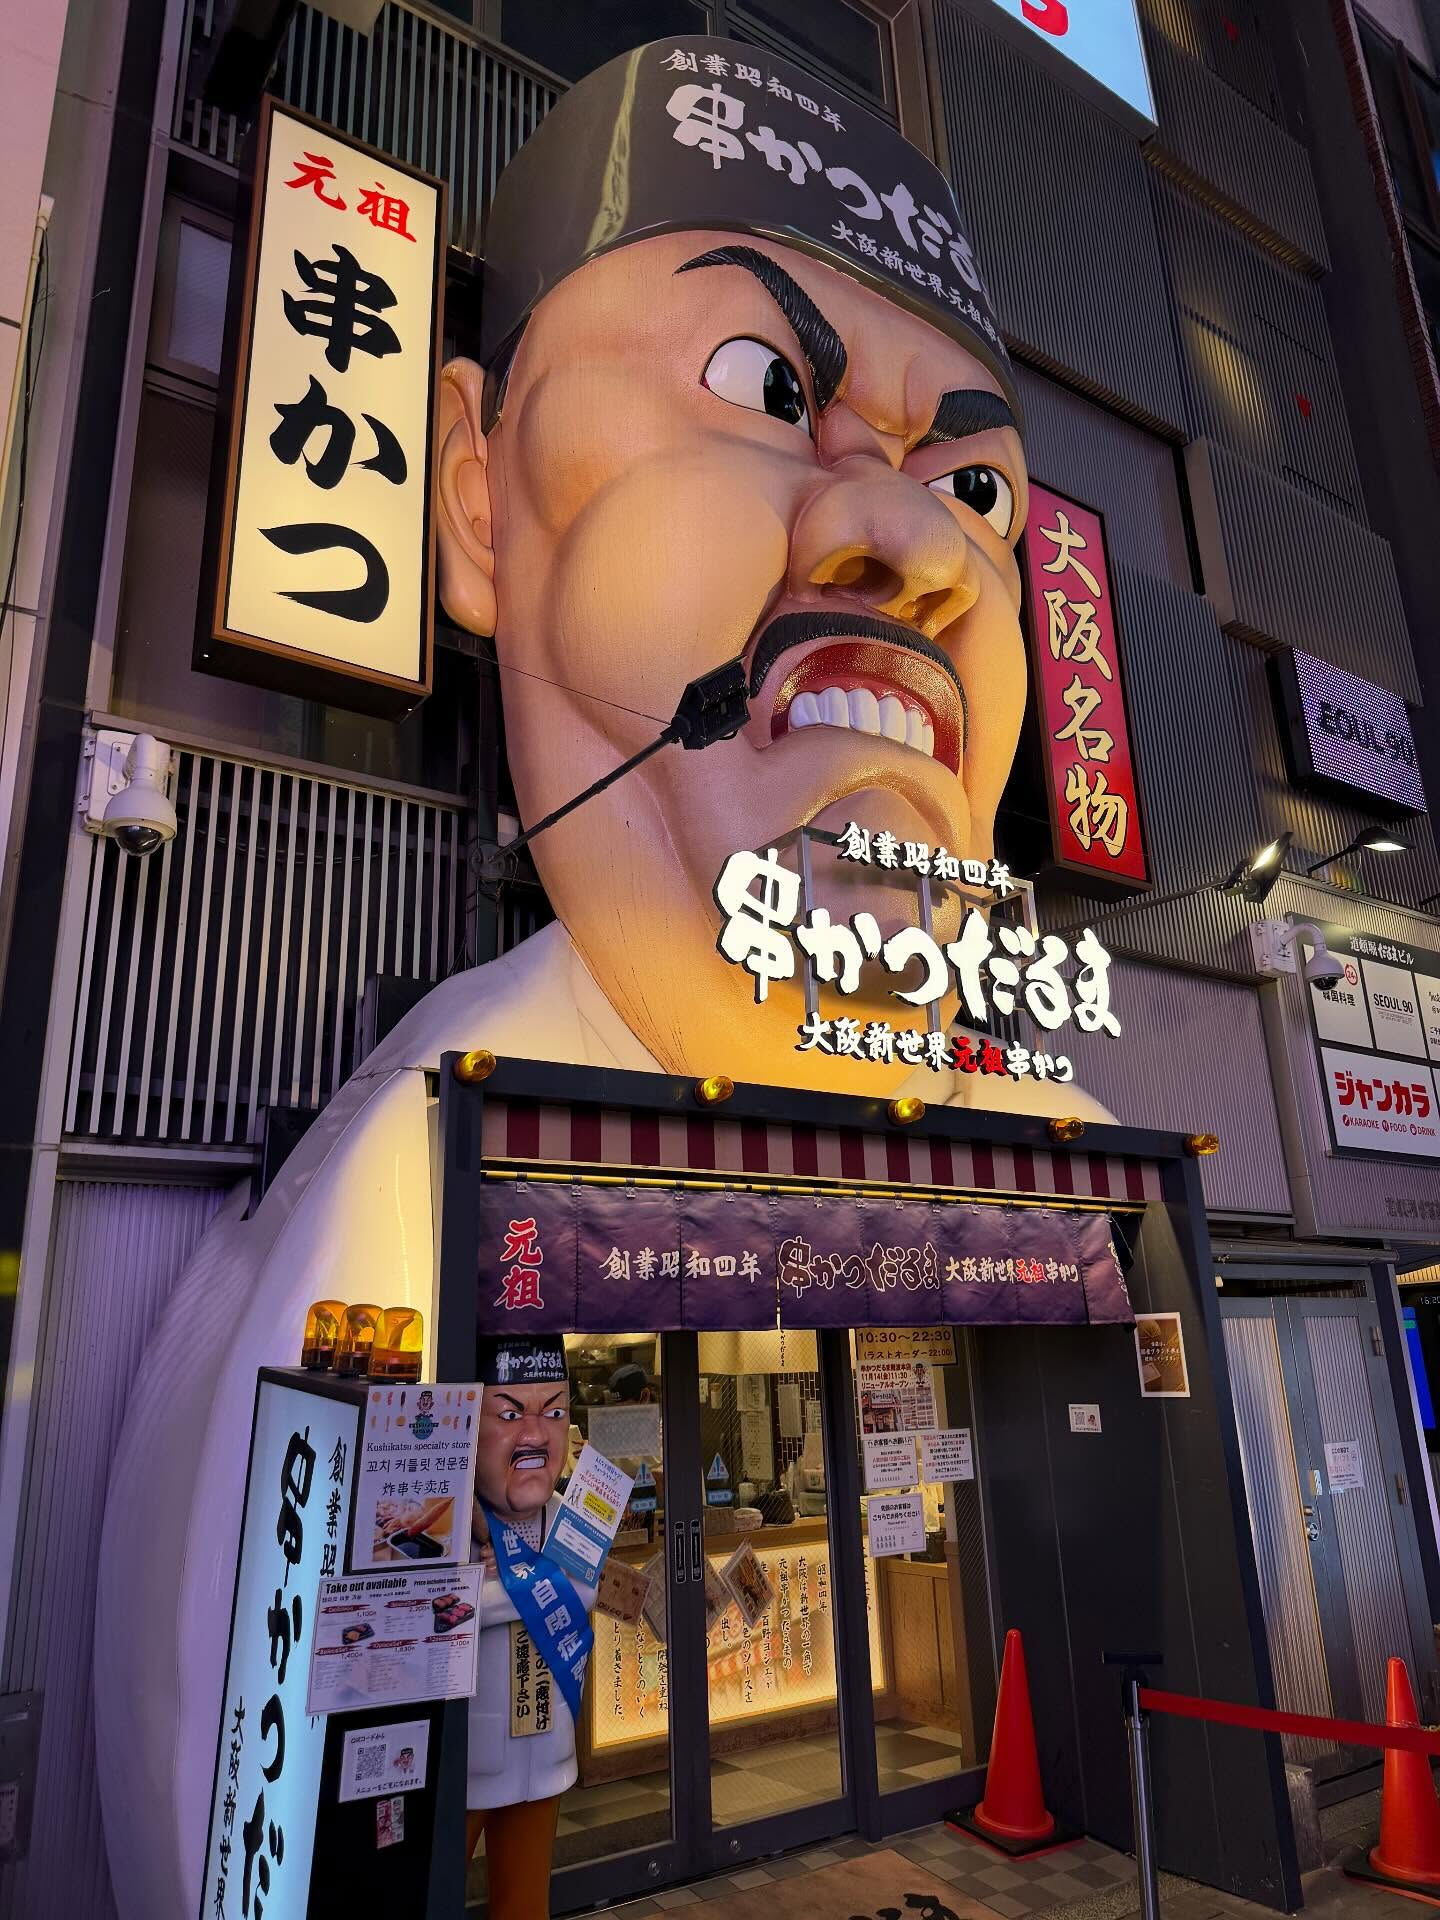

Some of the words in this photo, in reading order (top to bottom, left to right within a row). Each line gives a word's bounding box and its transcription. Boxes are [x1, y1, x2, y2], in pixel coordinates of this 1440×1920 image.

[660, 50, 847, 132] 創業昭和四年
[283, 150, 418, 244] 元祖
[665, 83, 983, 292] 串かつだる
[257, 243, 408, 624] 串かつ
[1039, 510, 1128, 857] 大阪名物
[837, 821, 1015, 897] 創業昭和四年
[713, 848, 1122, 1038] 串かつだるま
[1373, 993, 1403, 1012] SEOUL
[1402, 1000, 1414, 1014] 90
[796, 1011, 1075, 1084] 大阪新世界元祖串かつ
[1334, 1070, 1431, 1118] ジャンカラ
[1349, 1117, 1380, 1129] KARAOKE
[1390, 1122, 1408, 1133] FOOD
[1417, 1126, 1437, 1137] DRINK
[493, 1217, 545, 1310] 元祖
[599, 1246, 763, 1284] 創業昭和四年
[778, 1235, 941, 1299] 串かつだるま
[944, 1255, 1080, 1285] 大阪新世界元祖串かつ
[366, 1442, 412, 1452] Kushikatsu
[414, 1440, 450, 1451] specialty
[451, 1441, 471, 1449] store
[366, 1459, 391, 1473] 꼬치
[394, 1457, 431, 1473] 커틀릿
[434, 1456, 469, 1471] 전문점
[382, 1479, 451, 1497] 炸串专卖店
[326, 1583, 347, 1595] Take
[349, 1582, 365, 1592] out
[365, 1577, 408, 1591] available
[817, 1563, 828, 1612] 昭和四年
[514, 1630, 531, 1718] ご遠慮下さい
